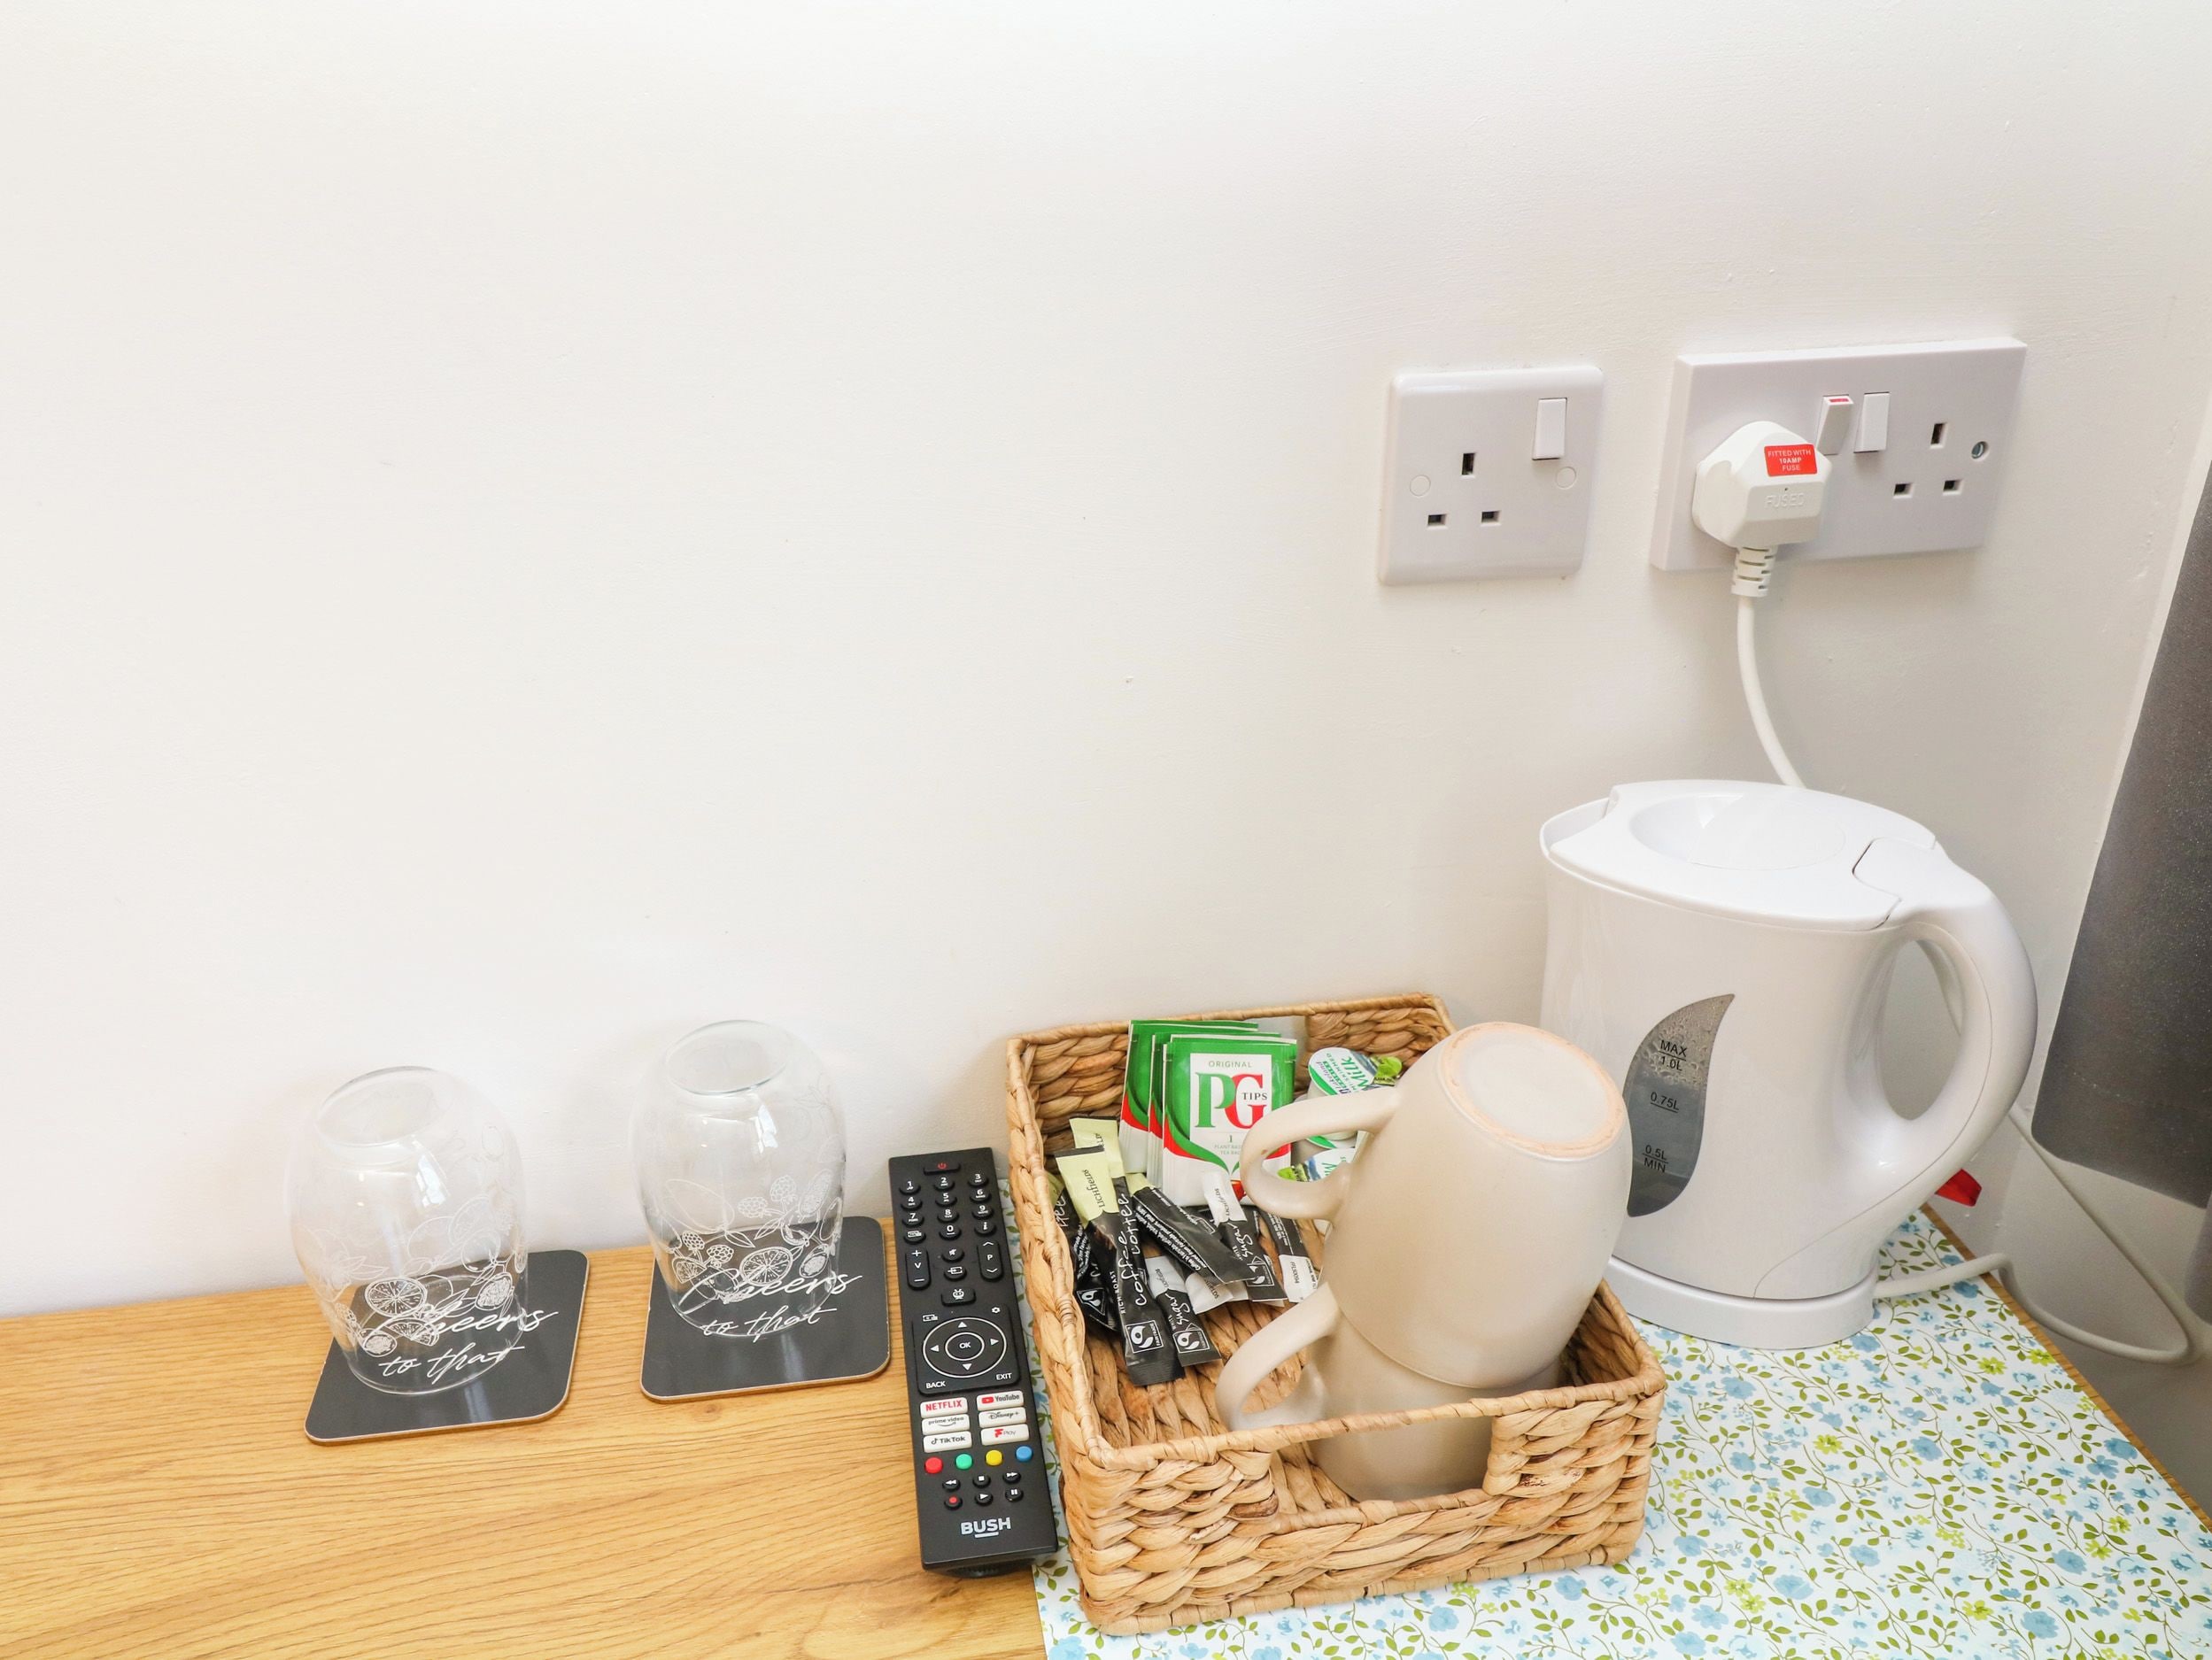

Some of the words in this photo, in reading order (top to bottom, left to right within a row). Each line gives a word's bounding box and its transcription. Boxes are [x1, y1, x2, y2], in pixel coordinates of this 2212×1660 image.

[1765, 492, 1806, 508] FUSED
[1660, 1039, 1687, 1057] MAX
[1661, 1055, 1682, 1071] 1.0L
[1195, 1072, 1267, 1129] PG
[1241, 1092, 1268, 1100] TIPS
[1650, 1092, 1680, 1110] 0.75L
[1644, 1144, 1667, 1161] 0.5L
[1644, 1158, 1667, 1172] MIN
[1226, 1223, 1253, 1258] Sugar
[1118, 1231, 1147, 1306] coffee
[1110, 1270, 1120, 1293] ROAST
[1164, 1293, 1190, 1325] Sugar
[700, 1320, 739, 1335] to
[744, 1305, 837, 1343] that
[378, 1356, 422, 1377] to
[427, 1342, 525, 1385] that
[925, 1400, 963, 1411] NETFLIX
[960, 1517, 1011, 1535] BUSH
